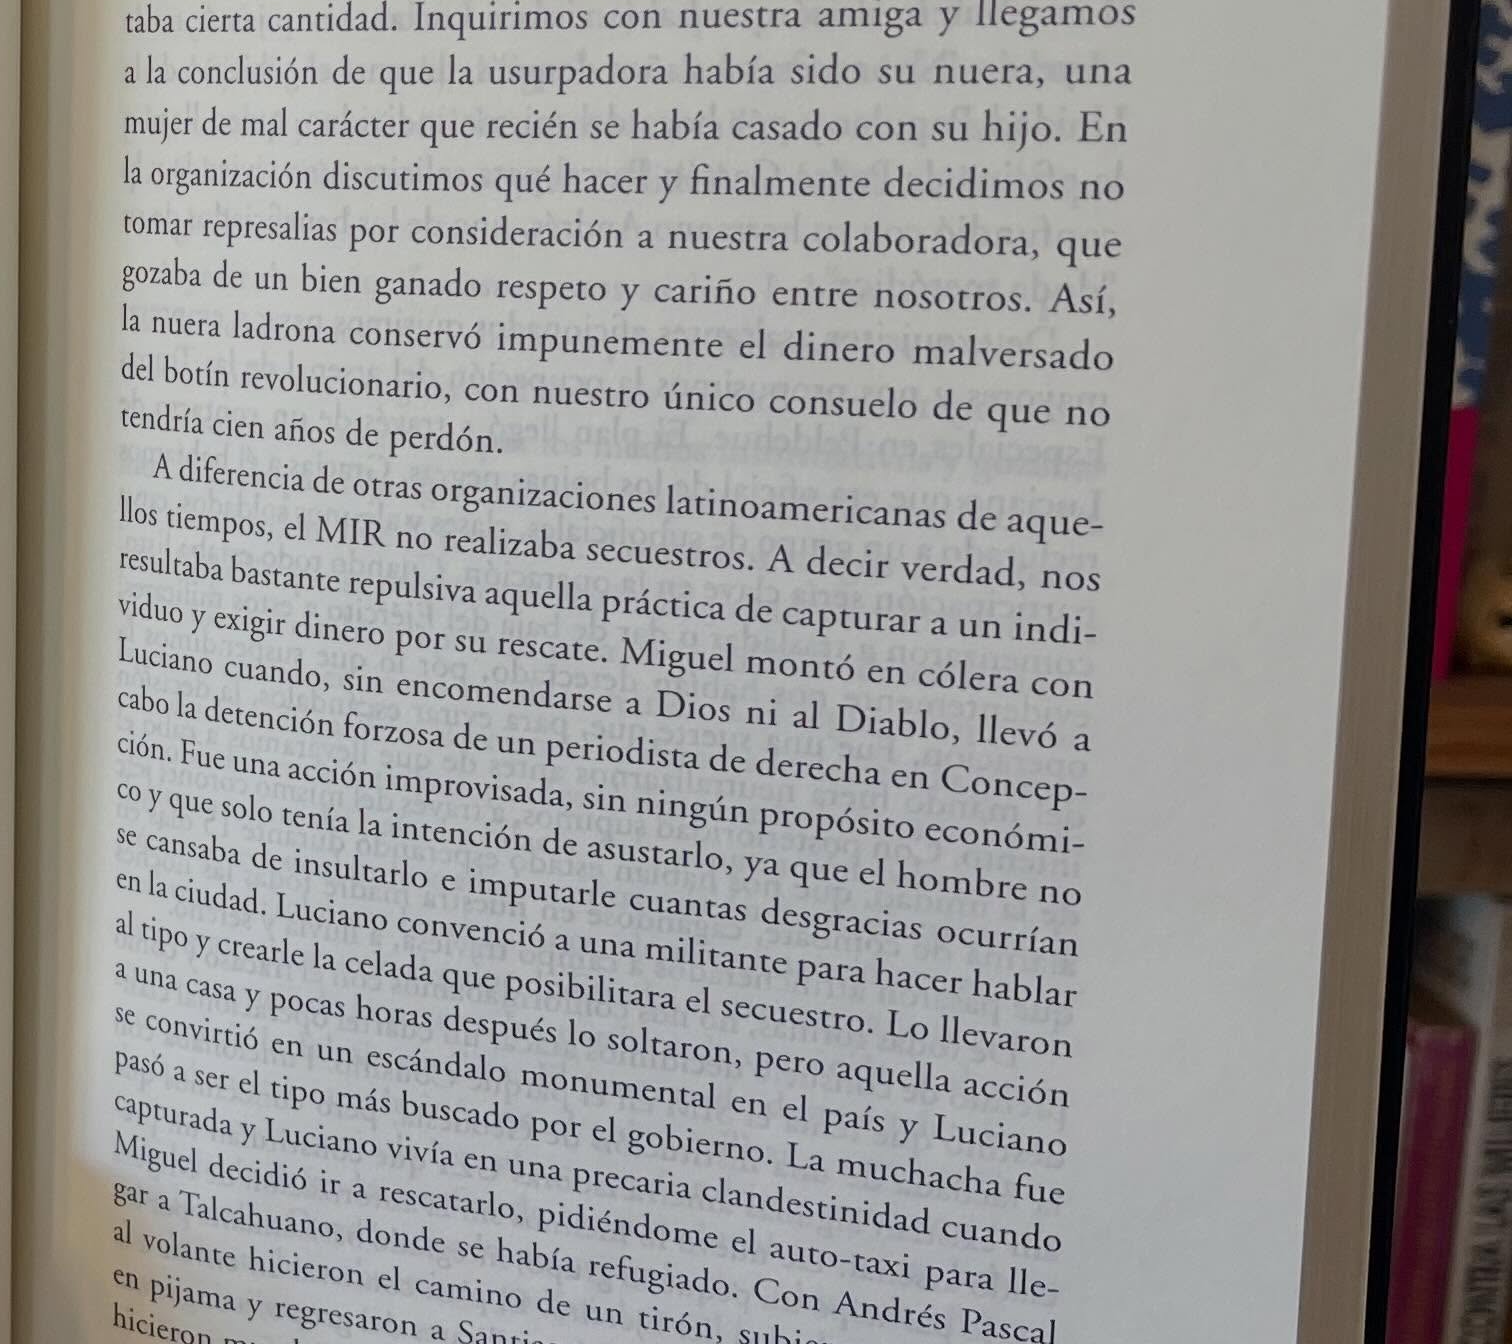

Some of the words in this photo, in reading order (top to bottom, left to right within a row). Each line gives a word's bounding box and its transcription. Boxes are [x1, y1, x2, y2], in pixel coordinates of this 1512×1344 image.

[124, 2, 176, 35] taba
[184, 3, 257, 34] cierta
[412, 0, 589, 42] Inquirimos
[602, 8, 663, 31] con
[678, 5, 803, 30] nuestra
[937, 5, 962, 38] y
[121, 255, 203, 294] gozaba
[211, 257, 244, 290] de
[253, 270, 290, 292] un
[300, 261, 362, 295] bien
[373, 265, 483, 306] ganado
[495, 278, 608, 311] respeto
[619, 282, 641, 313] y
[653, 273, 757, 306] cariño
[771, 285, 860, 309] entre
[872, 288, 1032, 314] nosotros.
[1046, 281, 1117, 320] Así,
[118, 546, 225, 583] resultaba
[230, 553, 341, 594] bastante
[347, 569, 478, 607] repulsiva
[484, 579, 594, 618] aquella
[600, 587, 727, 624] práctica
[734, 591, 774, 625] de
[781, 606, 922, 639] capturar
[929, 615, 949, 637] a
[958, 617, 1002, 640] un
[1013, 610, 1098, 646] indi-
[116, 732, 173, 763] ción.
[179, 737, 226, 771] Fue
[232, 754, 282, 779] una
[287, 757, 378, 790] acción
[384, 763, 574, 813] improvisada,
[581, 782, 628, 814] sin
[635, 788, 750, 830] ningún
[757, 805, 916, 842] propósito
[923, 821, 1086, 855] económi-
[112, 1181, 150, 1209] gar
[157, 1193, 172, 1213] a
[177, 1192, 344, 1244] Talcahuano,
[355, 1217, 447, 1255] donde
[456, 1239, 485, 1261] se
[495, 1235, 577, 1275] había
[587, 1253, 739, 1300] refugiado.
[752, 1276, 821, 1313] Con
[830, 1289, 947, 1331] Andrés
